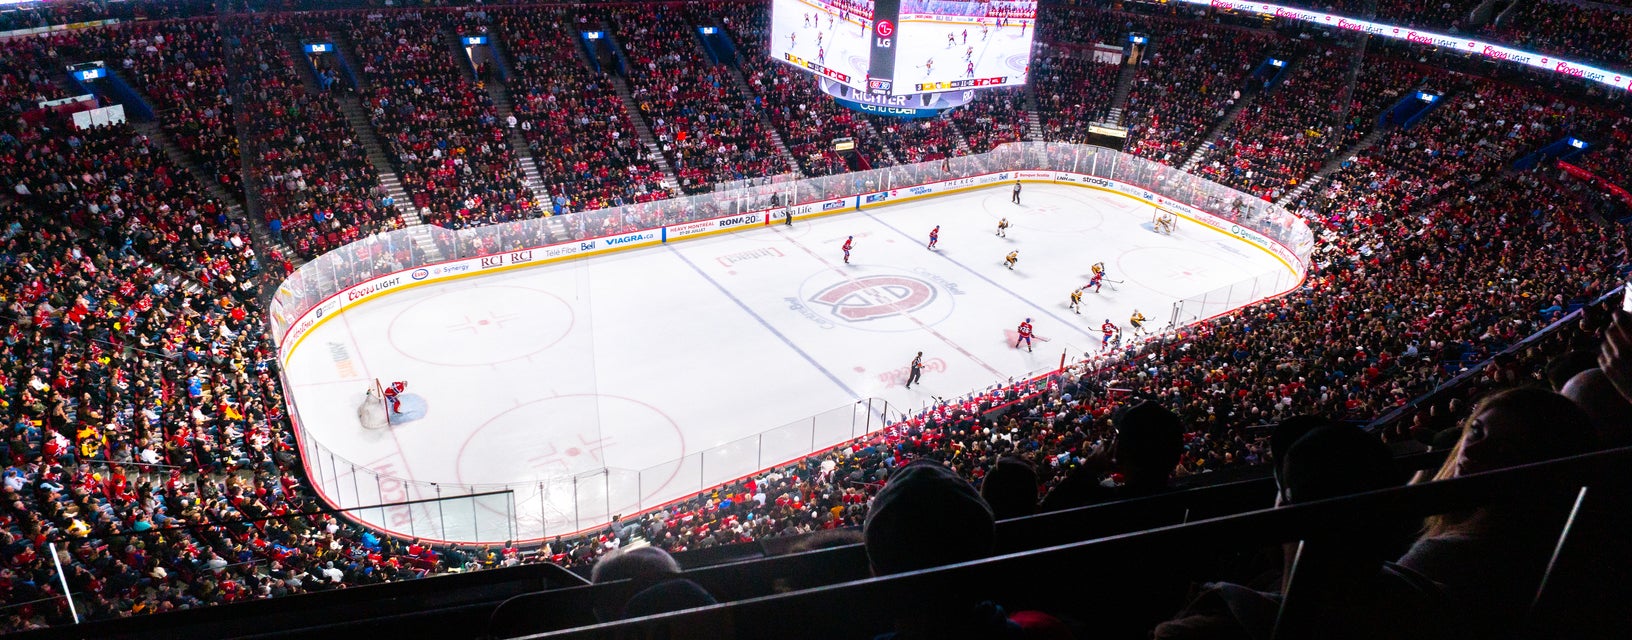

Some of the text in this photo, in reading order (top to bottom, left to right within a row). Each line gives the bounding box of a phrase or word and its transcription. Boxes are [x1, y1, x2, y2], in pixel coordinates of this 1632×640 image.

[877, 37, 891, 48] LG
[1407, 31, 1432, 45] Coors
[1484, 45, 1507, 59] Coors
[1556, 62, 1583, 76] Coors
[780, 206, 812, 217] Sn Life
[1172, 203, 1191, 214] CANADA
[720, 217, 744, 226] RONA
[745, 216, 756, 224] 20
[581, 242, 596, 250] Bell
[481, 250, 532, 266] RCI RCI
[348, 278, 400, 301] Coors LIGHT
